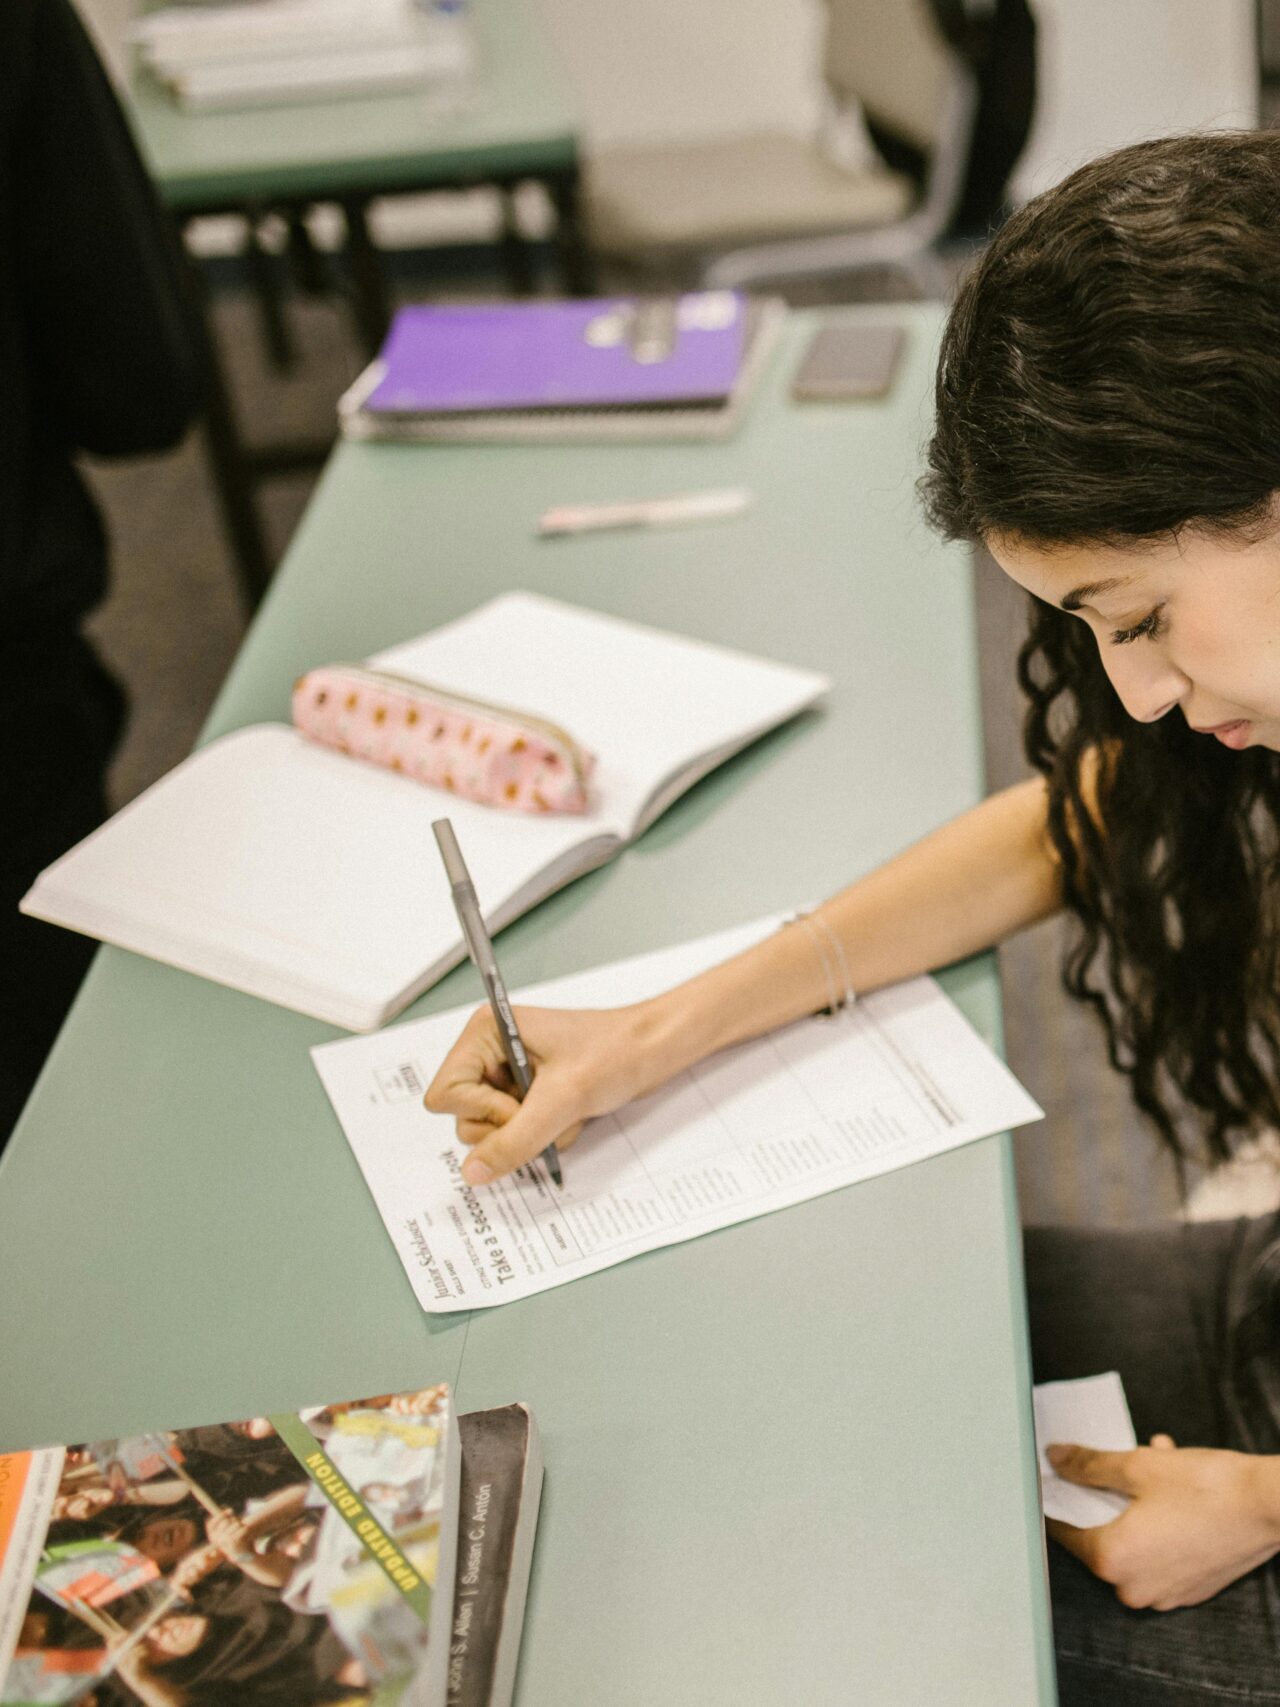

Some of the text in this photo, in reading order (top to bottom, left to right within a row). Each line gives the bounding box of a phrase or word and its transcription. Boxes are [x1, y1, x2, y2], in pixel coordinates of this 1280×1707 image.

[454, 1185, 491, 1234] Second
[405, 1219, 456, 1299] Junior Scholastic
[484, 1236, 498, 1247] a
[490, 1248, 515, 1285] Take
[472, 1483, 492, 1522] Antón
[306, 1452, 418, 1593] UPDATED EDITION
[469, 1523, 486, 1541] C.
[461, 1543, 484, 1585] Susan
[454, 1601, 473, 1637] Allen
